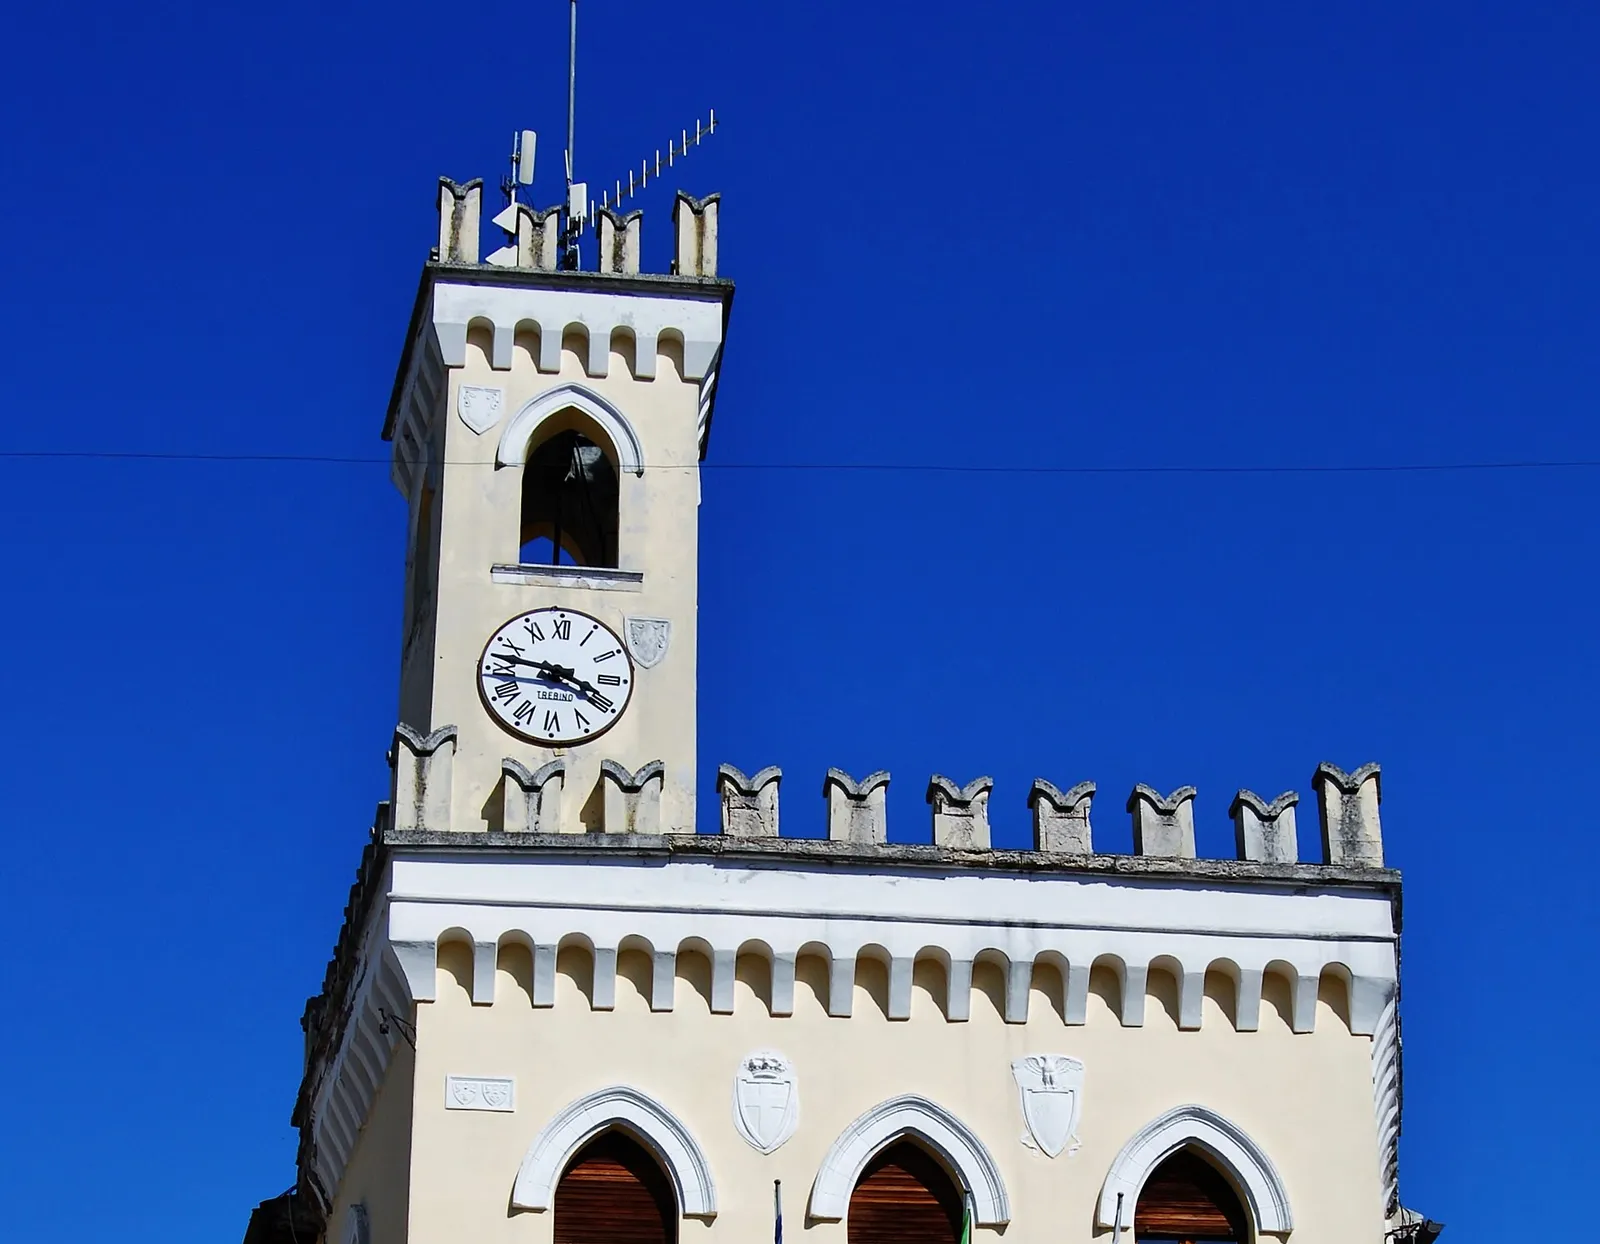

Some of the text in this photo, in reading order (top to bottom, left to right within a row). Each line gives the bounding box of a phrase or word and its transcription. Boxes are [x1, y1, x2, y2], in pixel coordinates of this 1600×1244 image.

[523, 622, 545, 645] XI
[552, 619, 571, 641] XII
[502, 637, 525, 657] X
[593, 650, 615, 663] II
[598, 674, 620, 686] III
[494, 681, 521, 707] VIII
[537, 690, 574, 702] TREBINO
[513, 699, 536, 725] VII
[543, 709, 560, 732] VI
[574, 707, 590, 729] V
